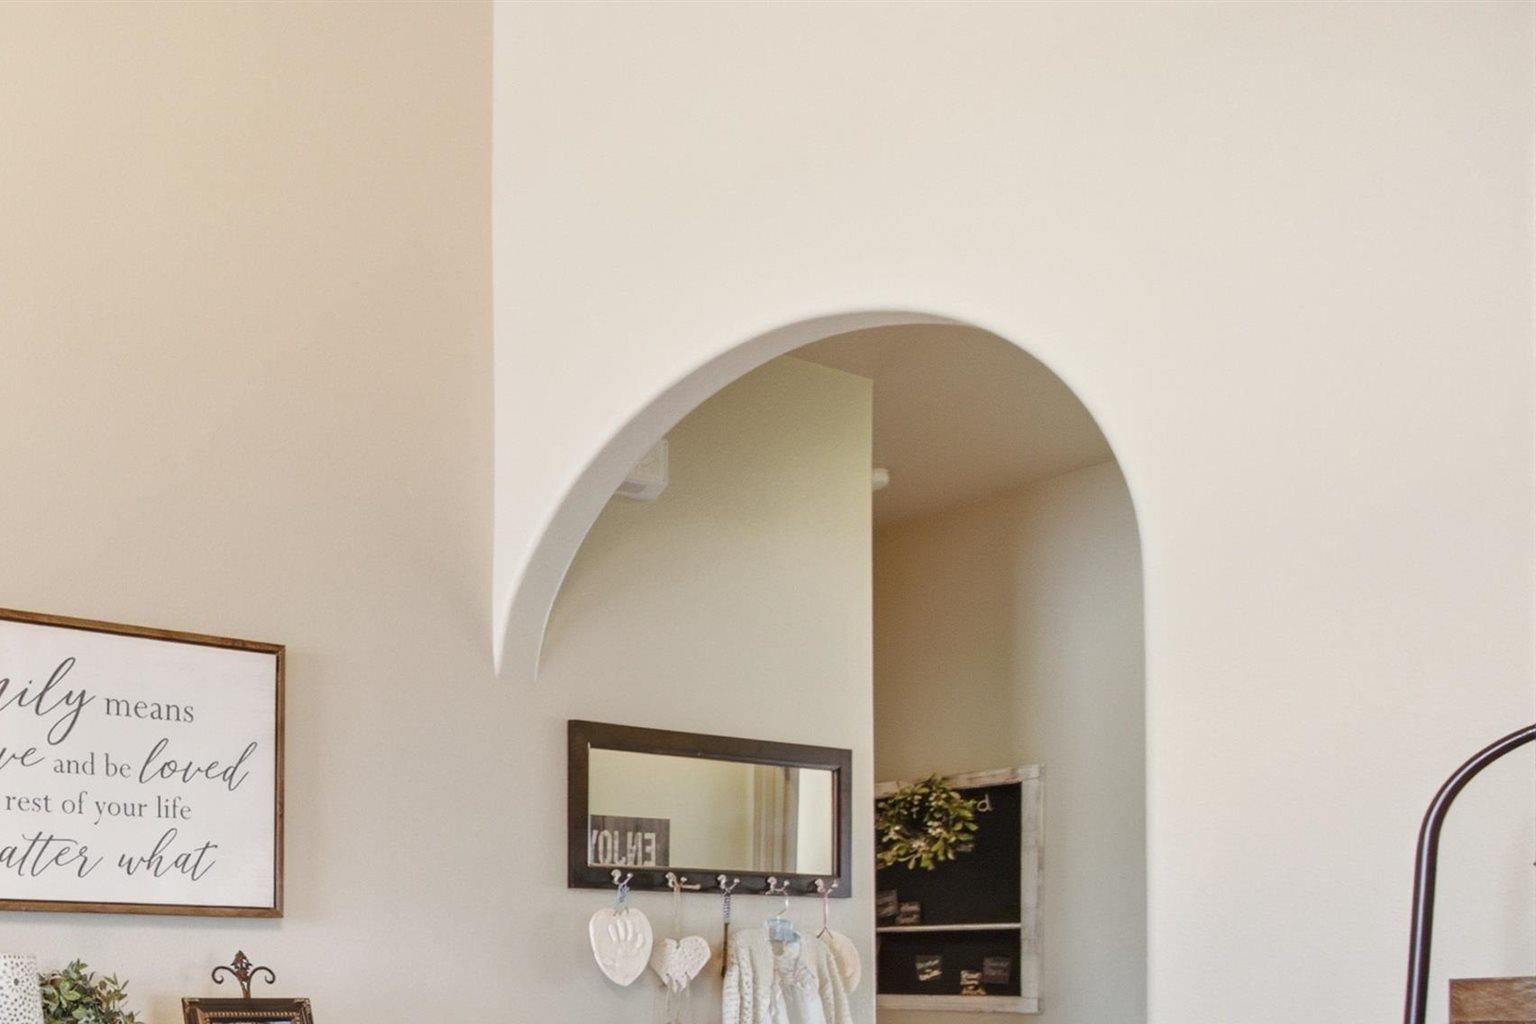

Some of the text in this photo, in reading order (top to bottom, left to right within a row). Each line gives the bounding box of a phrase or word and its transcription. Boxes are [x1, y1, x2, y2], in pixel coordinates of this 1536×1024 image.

[105, 696, 195, 723] means
[53, 752, 96, 777] and
[105, 754, 132, 779] be
[138, 738, 259, 791] loved
[5, 792, 53, 813] rest
[61, 787, 90, 815] of
[94, 797, 148, 825] your
[156, 795, 192, 821] life
[117, 827, 218, 882] what
